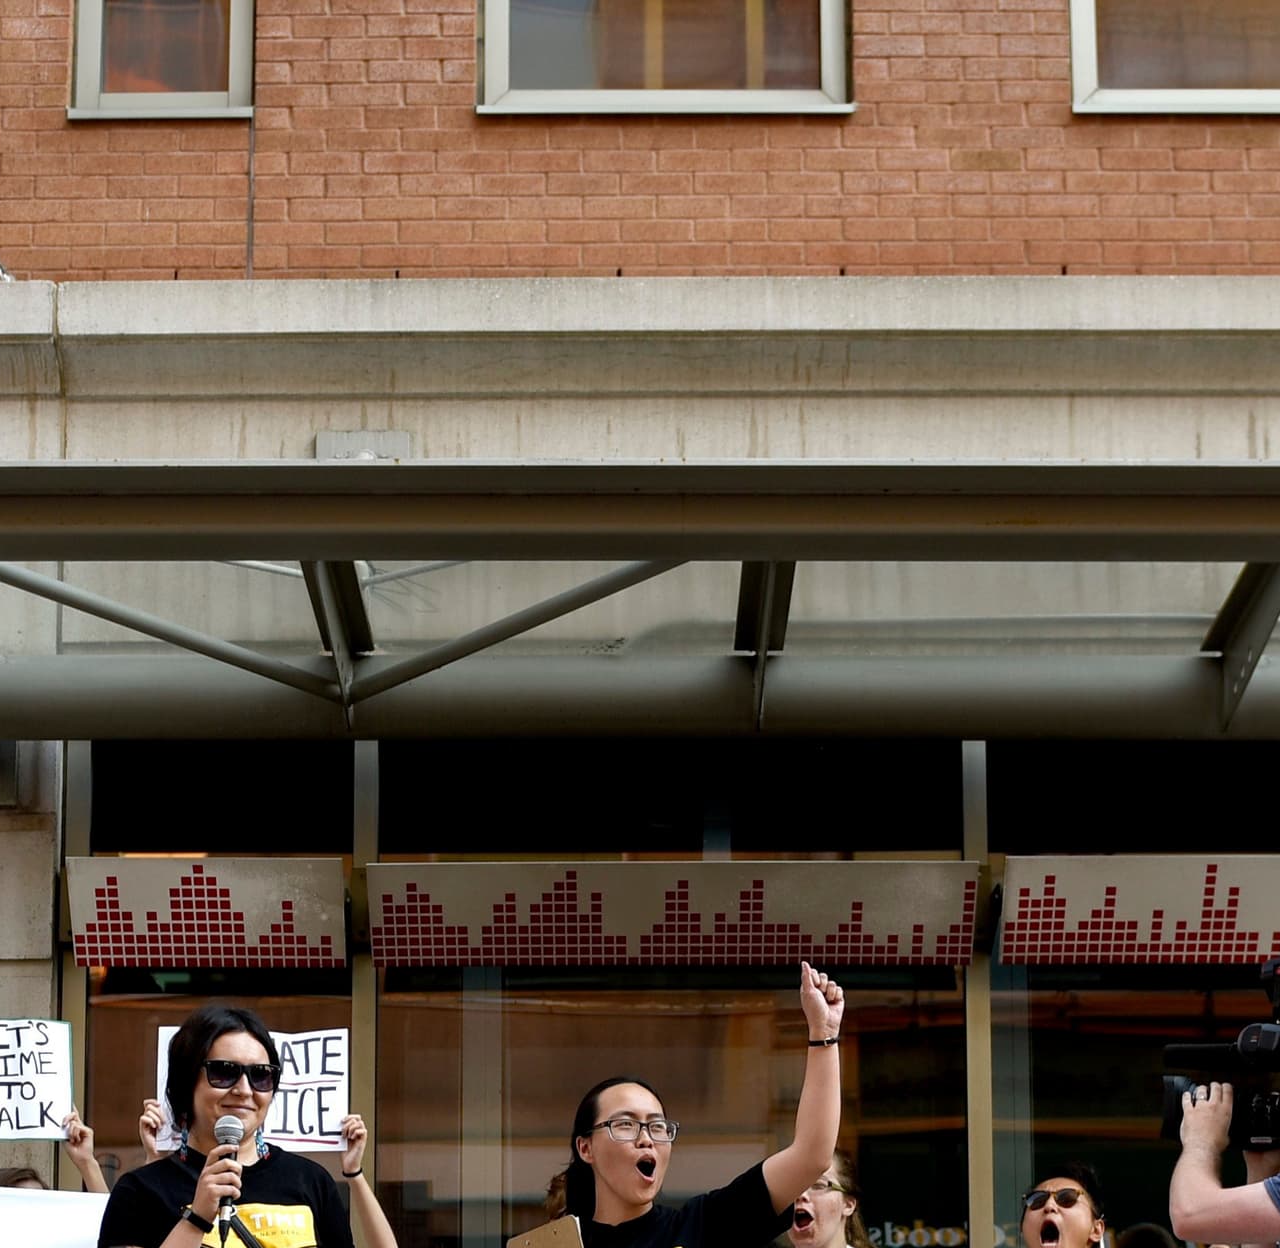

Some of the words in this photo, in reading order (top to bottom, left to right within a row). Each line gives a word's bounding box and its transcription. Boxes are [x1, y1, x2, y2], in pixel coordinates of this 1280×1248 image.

[280, 1036, 344, 1076] ATE
[271, 1086, 342, 1136] ICE
[250, 1212, 306, 1230] TIME
